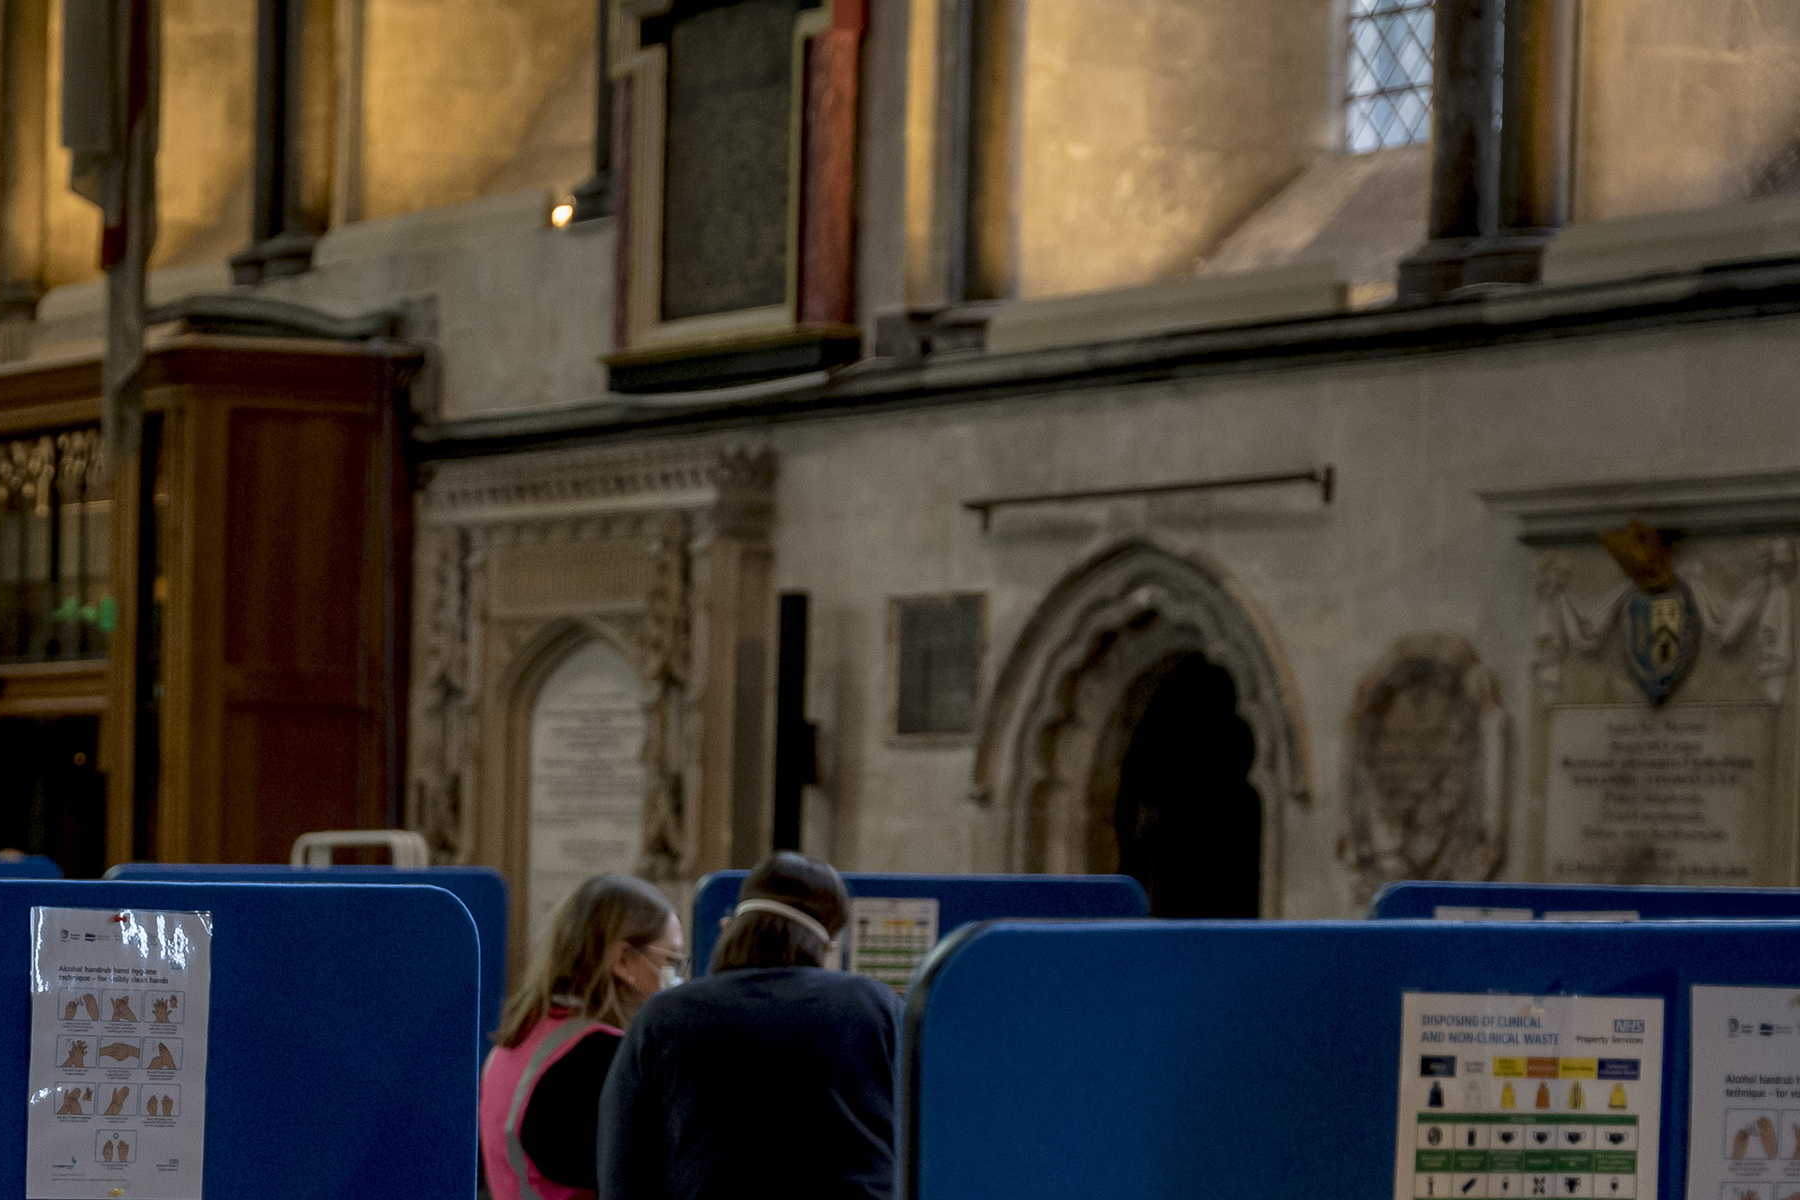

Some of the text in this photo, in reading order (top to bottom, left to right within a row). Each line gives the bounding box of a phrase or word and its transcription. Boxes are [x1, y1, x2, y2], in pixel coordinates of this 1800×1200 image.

[59, 965, 157, 977] Alcohol handrub hand hygene
[149, 977, 169, 985] hands
[1421, 1014, 1542, 1029] DISPOSING OF CLINICAL
[1613, 1019, 1645, 1033] NHS
[1421, 1031, 1560, 1046] AND NON-CLINICAL WASTE
[1576, 1034, 1644, 1045] Property Services
[1726, 1074, 1794, 1084] Alcohol handrub
[1726, 1088, 1767, 1099] technique
[1776, 1088, 1789, 1099] for
